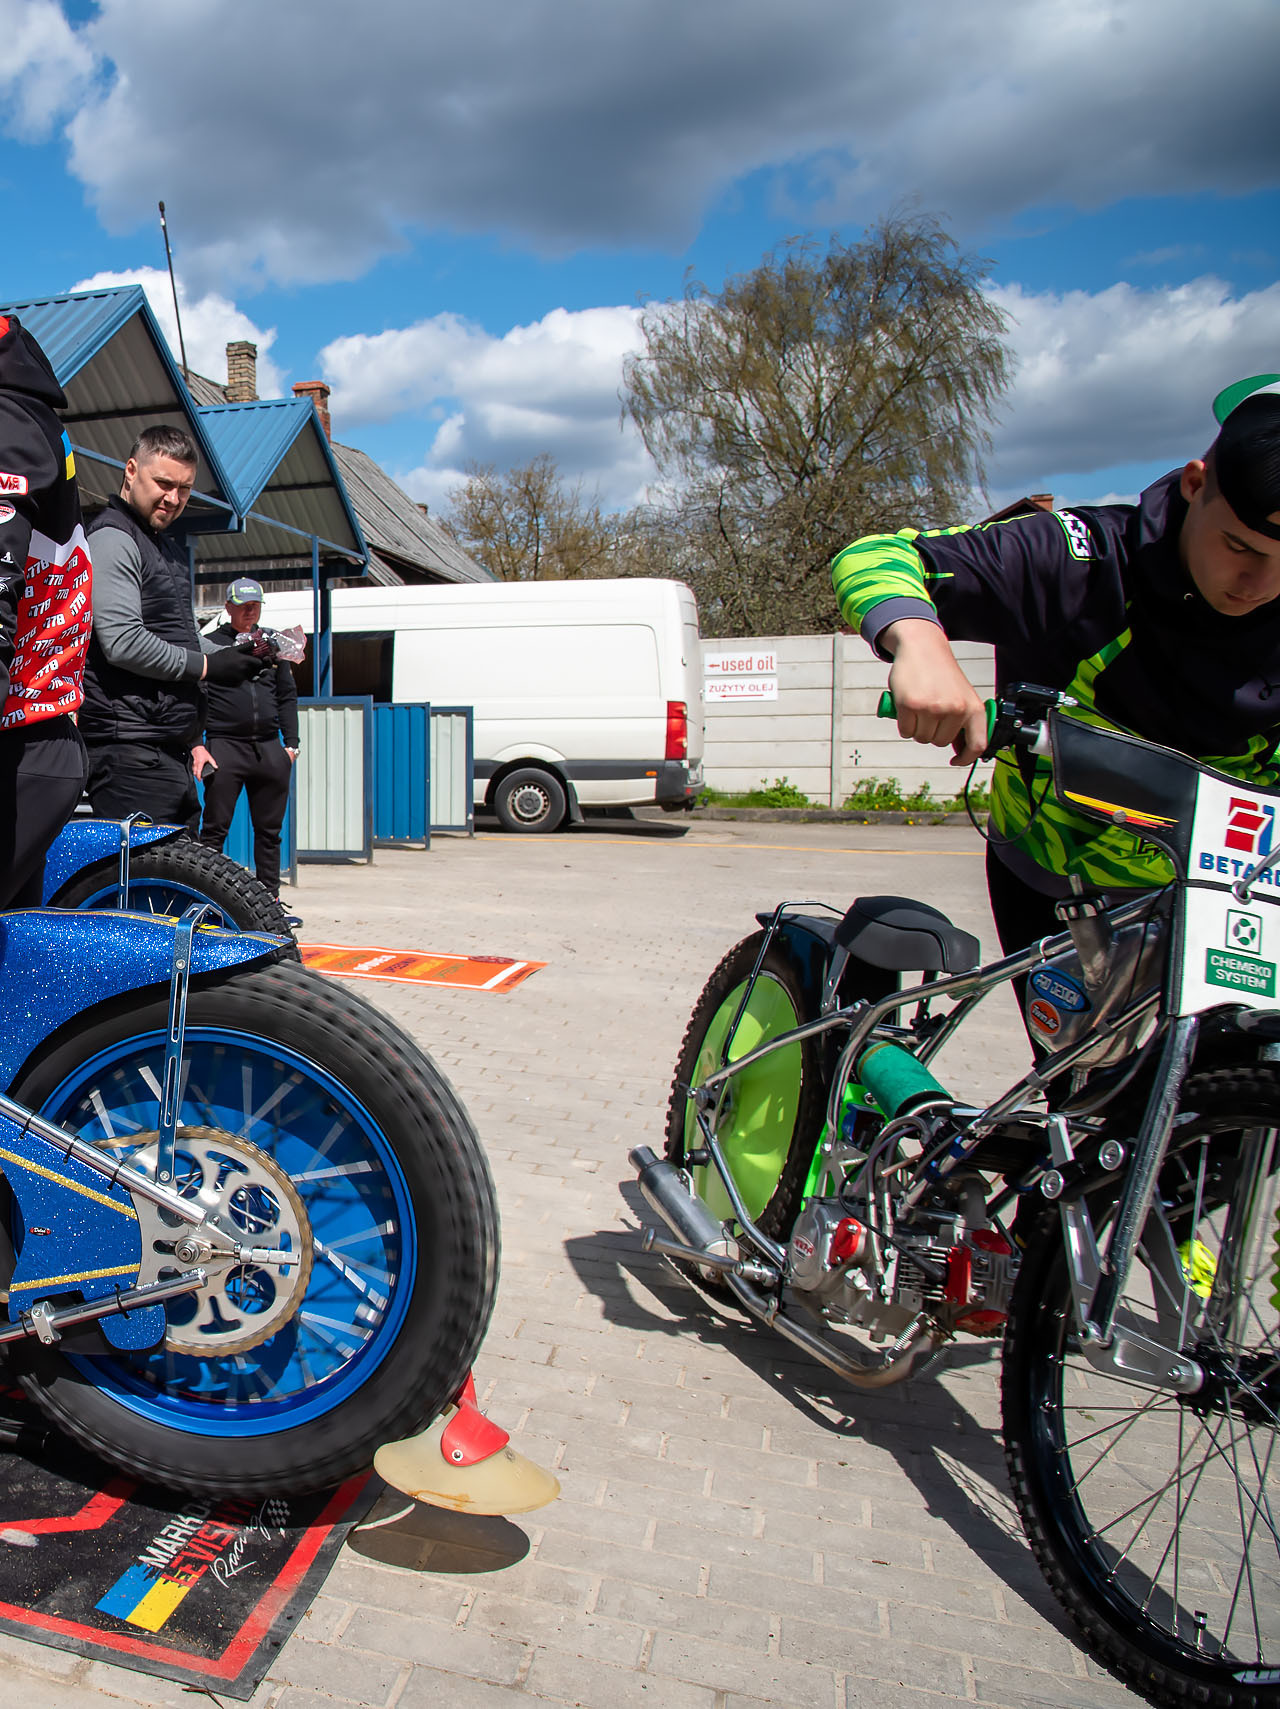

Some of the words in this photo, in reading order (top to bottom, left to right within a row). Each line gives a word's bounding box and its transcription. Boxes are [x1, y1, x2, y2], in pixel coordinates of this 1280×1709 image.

[721, 656, 753, 672] used
[757, 655, 775, 671] oil
[748, 683, 774, 692] OLEJ
[1209, 954, 1273, 979] CHEMEKO
[1214, 968, 1268, 990] SYSTEM
[1050, 981, 1081, 1006] DESIGN
